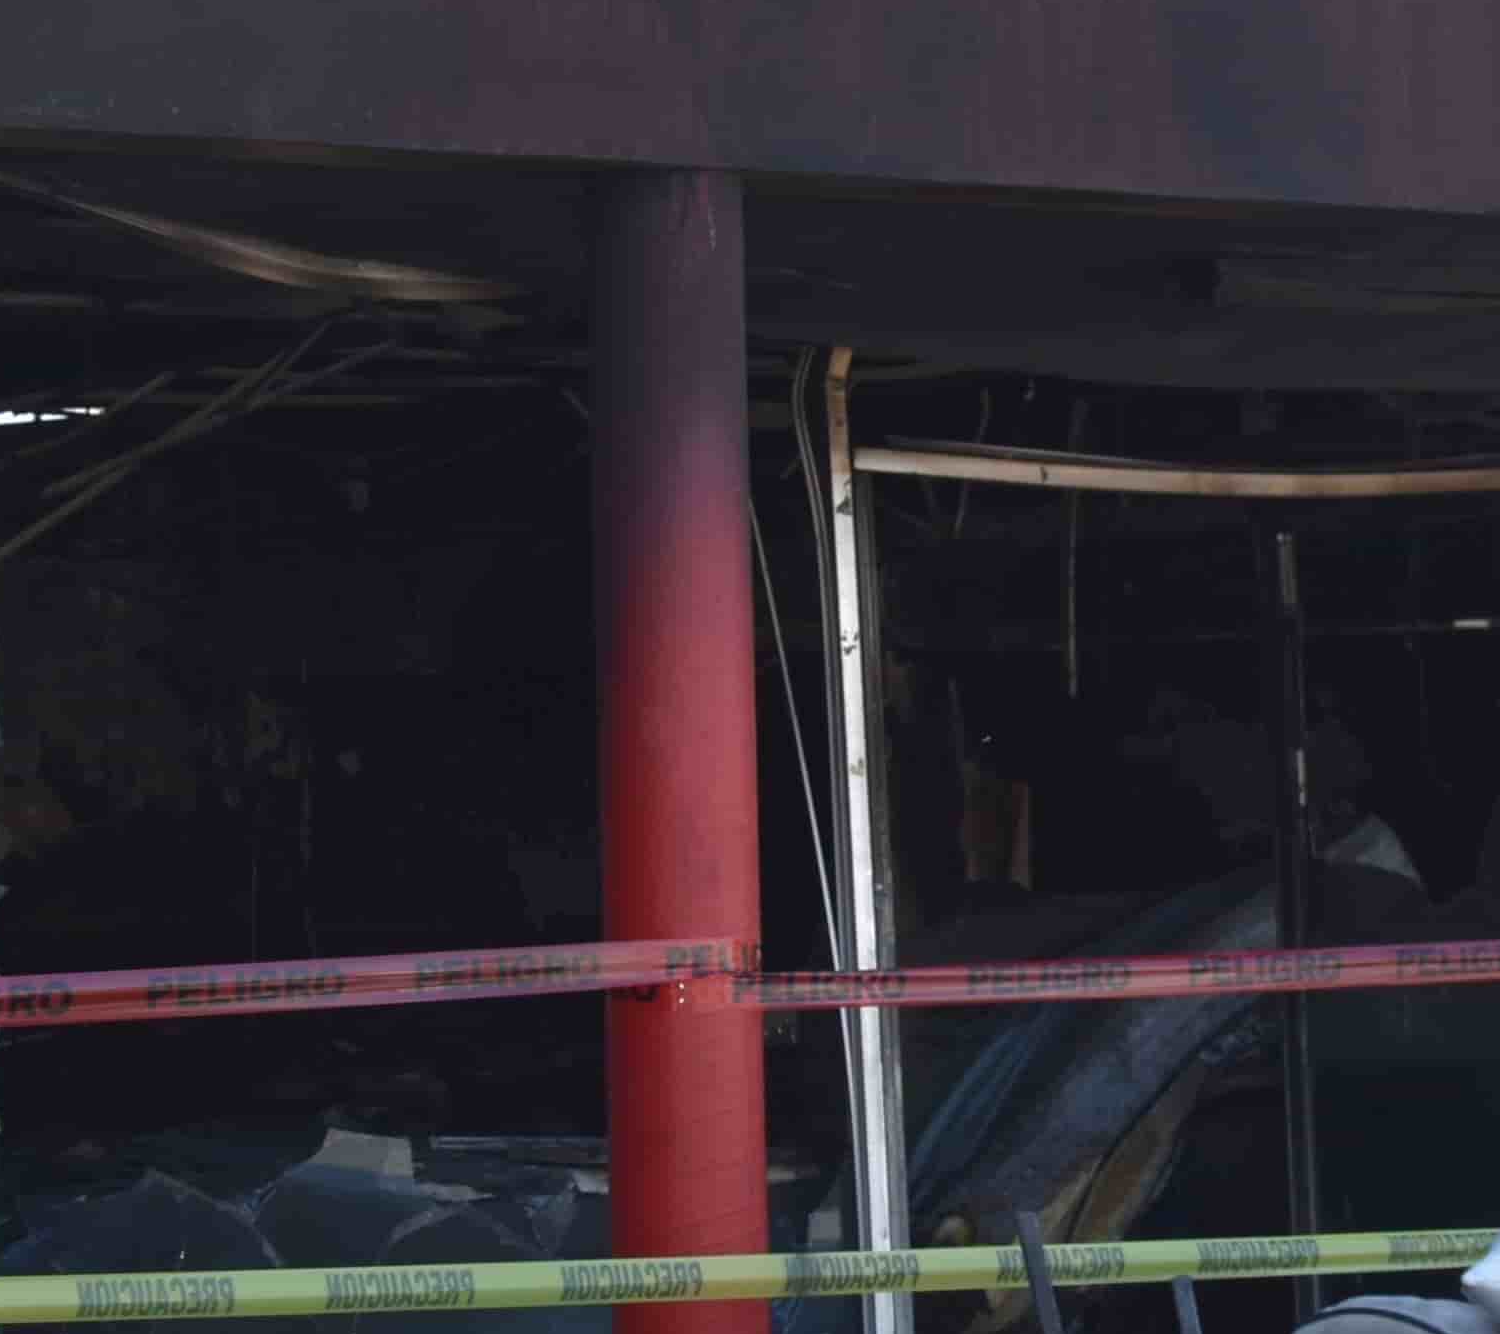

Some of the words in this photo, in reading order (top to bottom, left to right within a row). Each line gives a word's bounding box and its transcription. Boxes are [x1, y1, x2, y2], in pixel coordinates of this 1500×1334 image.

[147, 968, 347, 1008] PELIGRO
[415, 953, 600, 990] PELIGRO
[967, 963, 1132, 995] PELIGRO
[1189, 953, 1342, 986] PELIGRO
